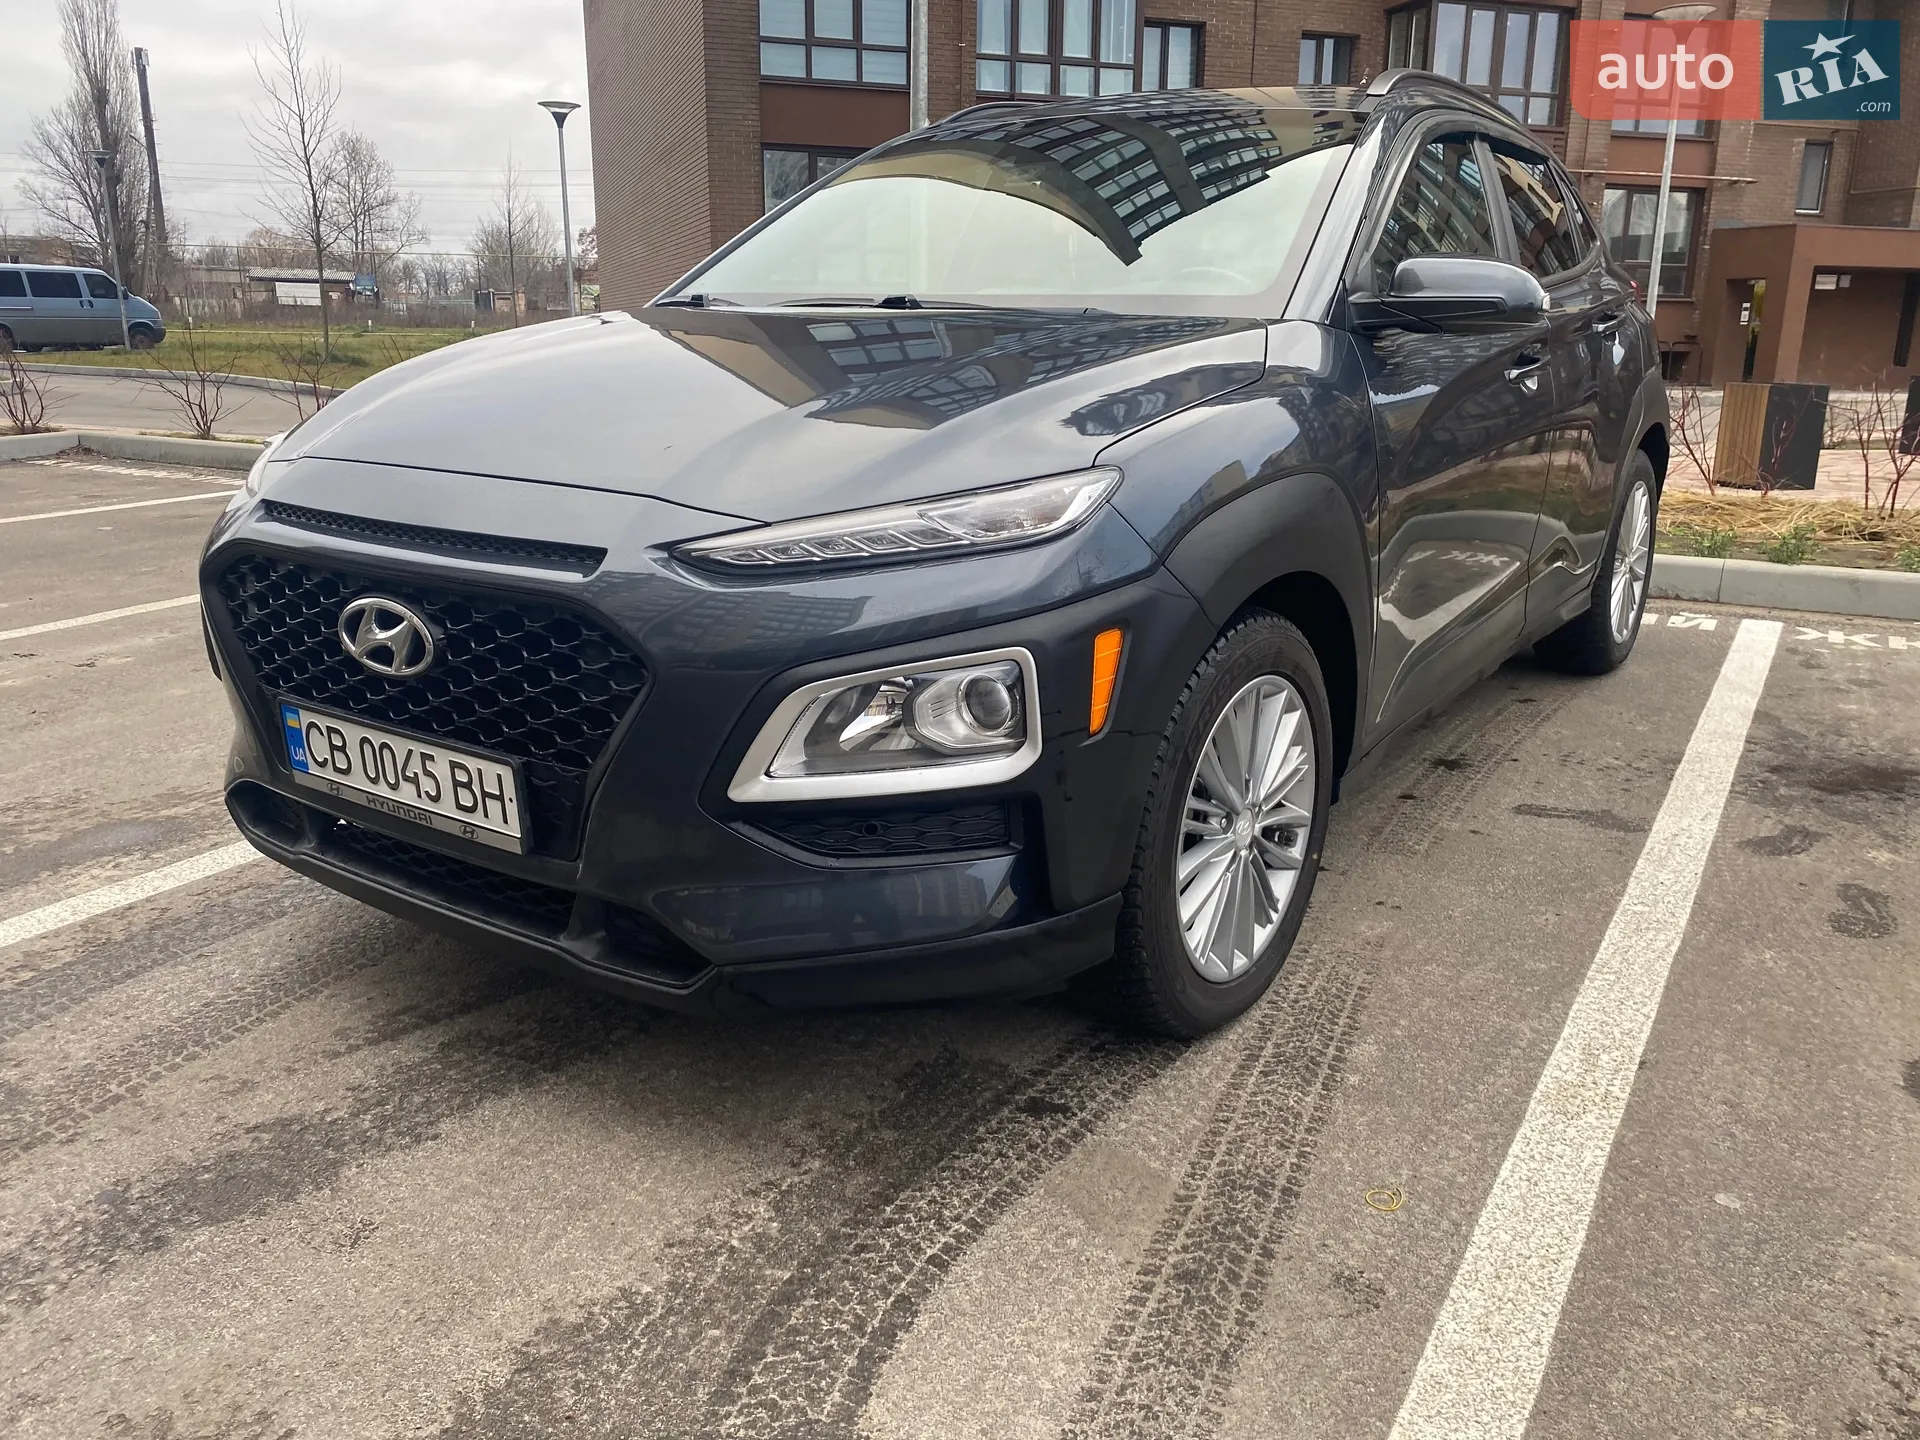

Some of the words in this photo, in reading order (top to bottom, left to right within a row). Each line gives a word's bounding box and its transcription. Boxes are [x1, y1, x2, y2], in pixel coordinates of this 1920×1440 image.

[291, 745, 307, 763] UA
[305, 719, 352, 776] CB
[358, 735, 442, 803] 0045
[449, 758, 509, 825] BH
[366, 794, 433, 826] HYUNDAI
